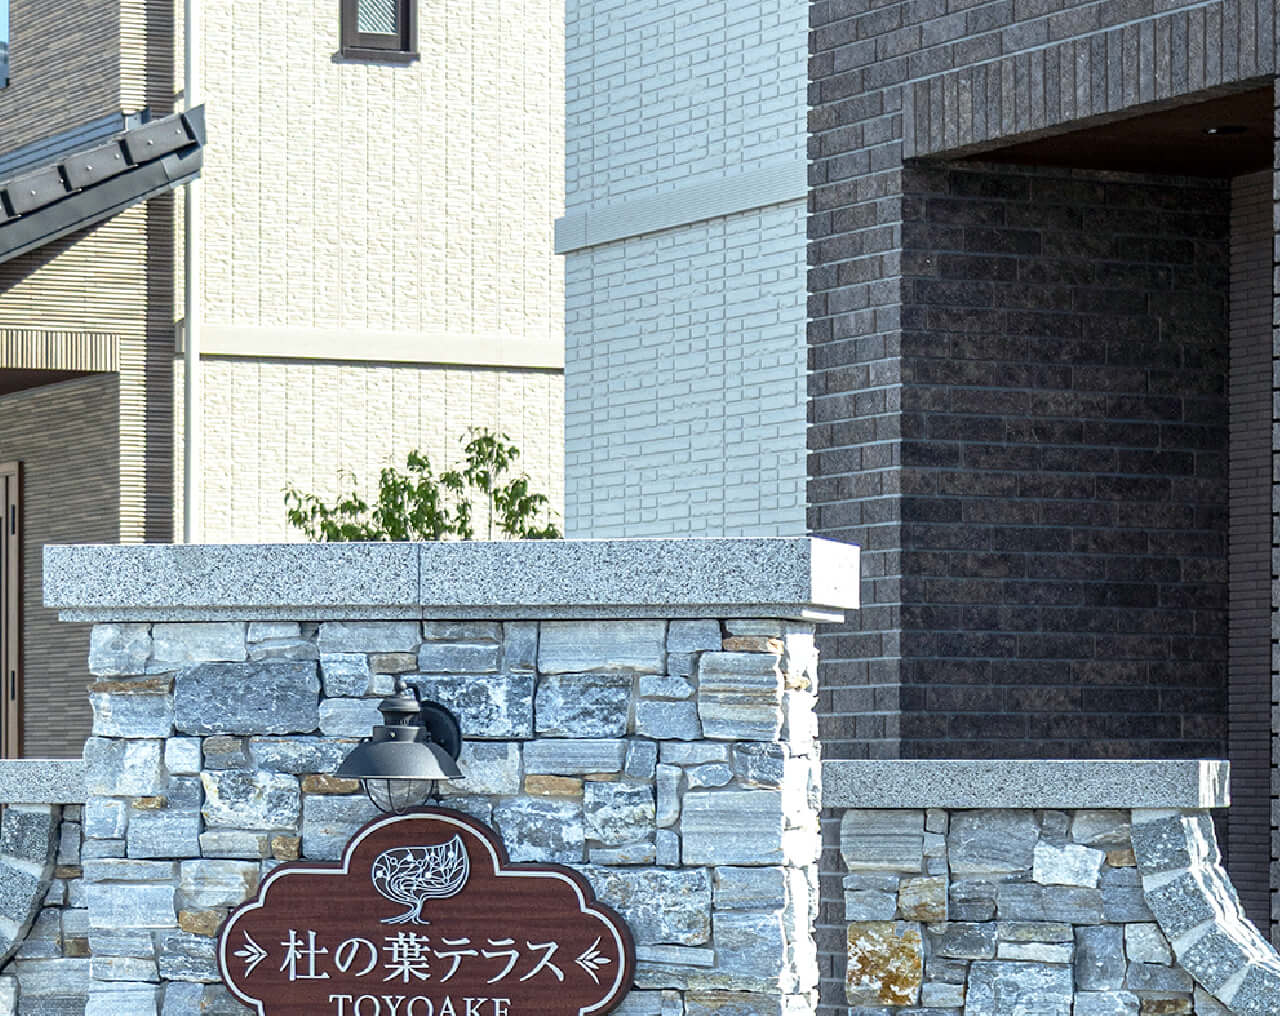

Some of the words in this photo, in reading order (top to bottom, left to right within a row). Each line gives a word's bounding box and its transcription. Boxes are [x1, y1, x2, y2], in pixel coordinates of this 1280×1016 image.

[280, 929, 565, 984] 杜の葉テラス
